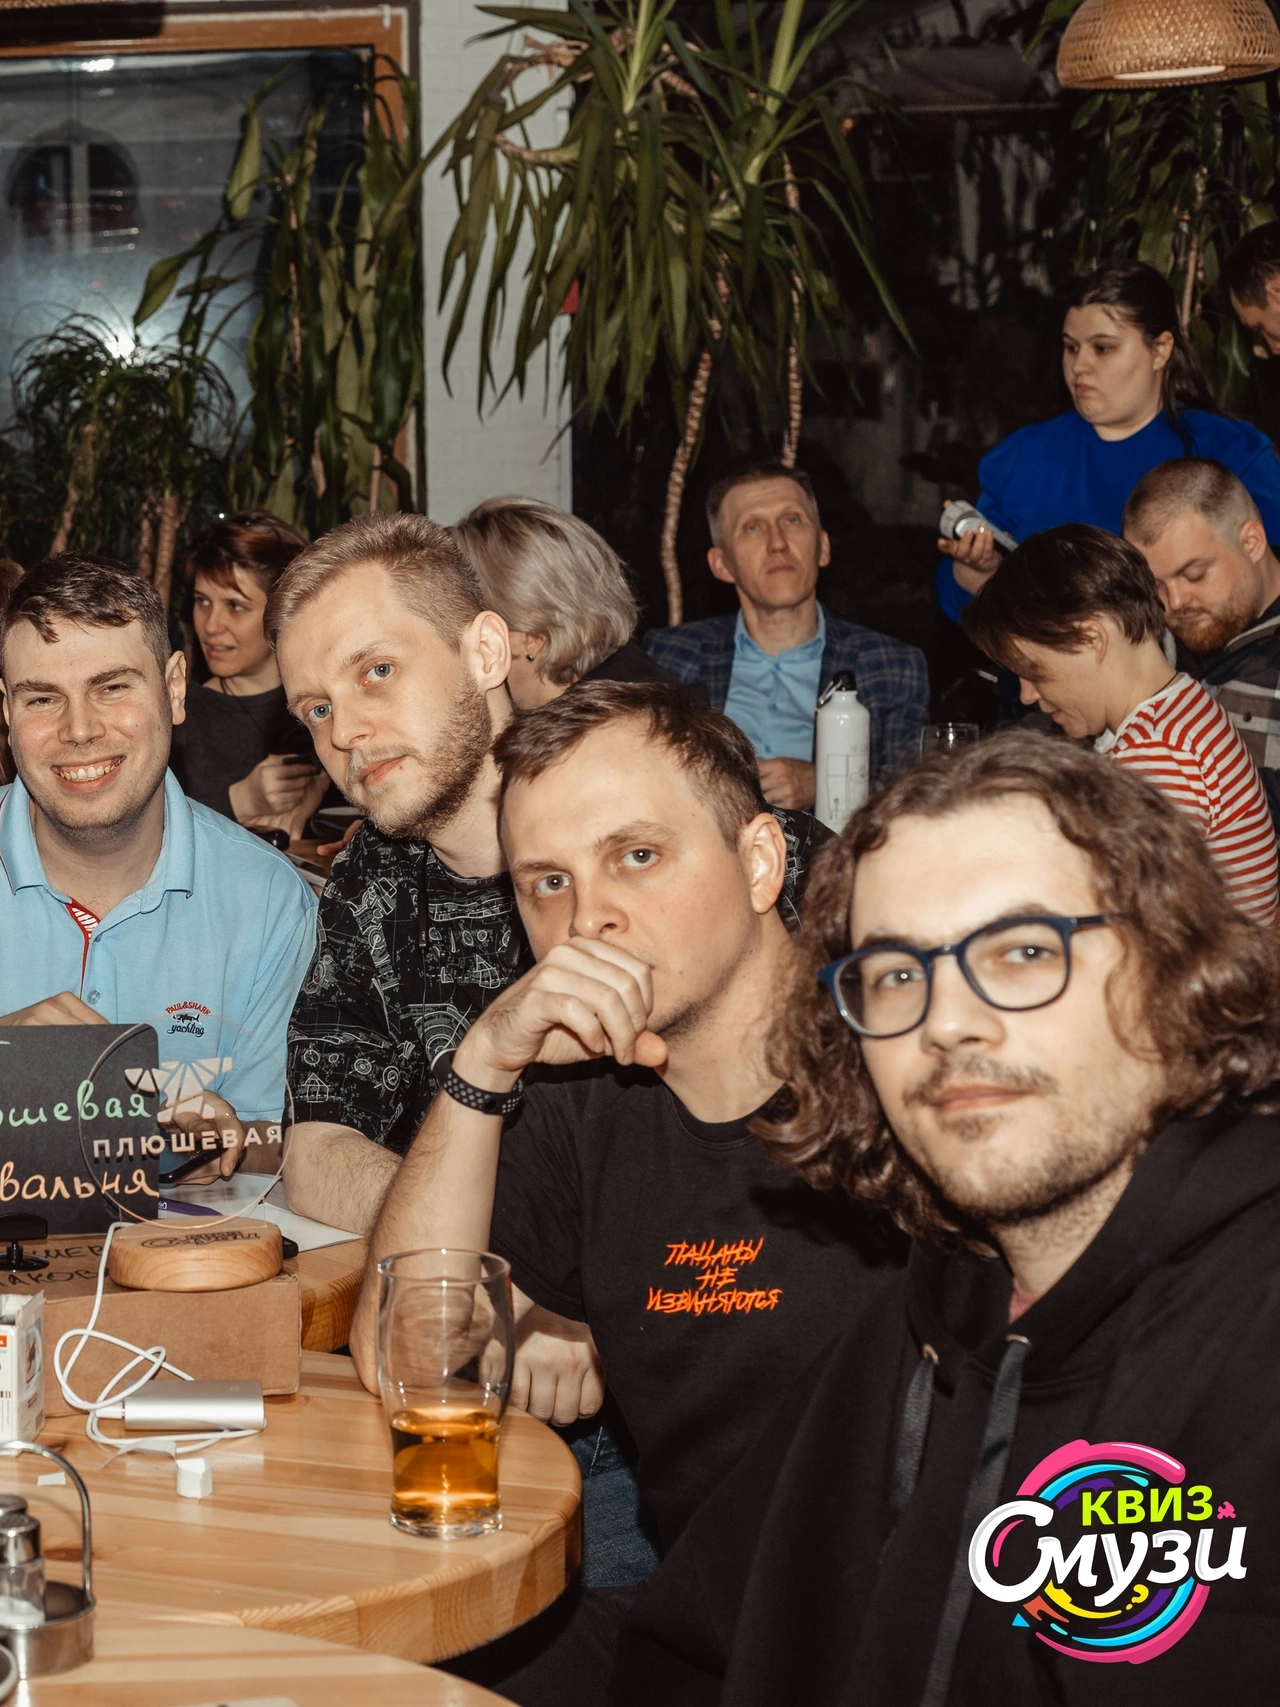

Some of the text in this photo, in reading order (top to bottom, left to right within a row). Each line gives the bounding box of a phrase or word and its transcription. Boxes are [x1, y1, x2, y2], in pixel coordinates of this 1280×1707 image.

[167, 1022, 205, 1037] yachting
[93, 1125, 283, 1158] ПЛЮШЕВАЯ
[696, 1265, 738, 1289] НЕ
